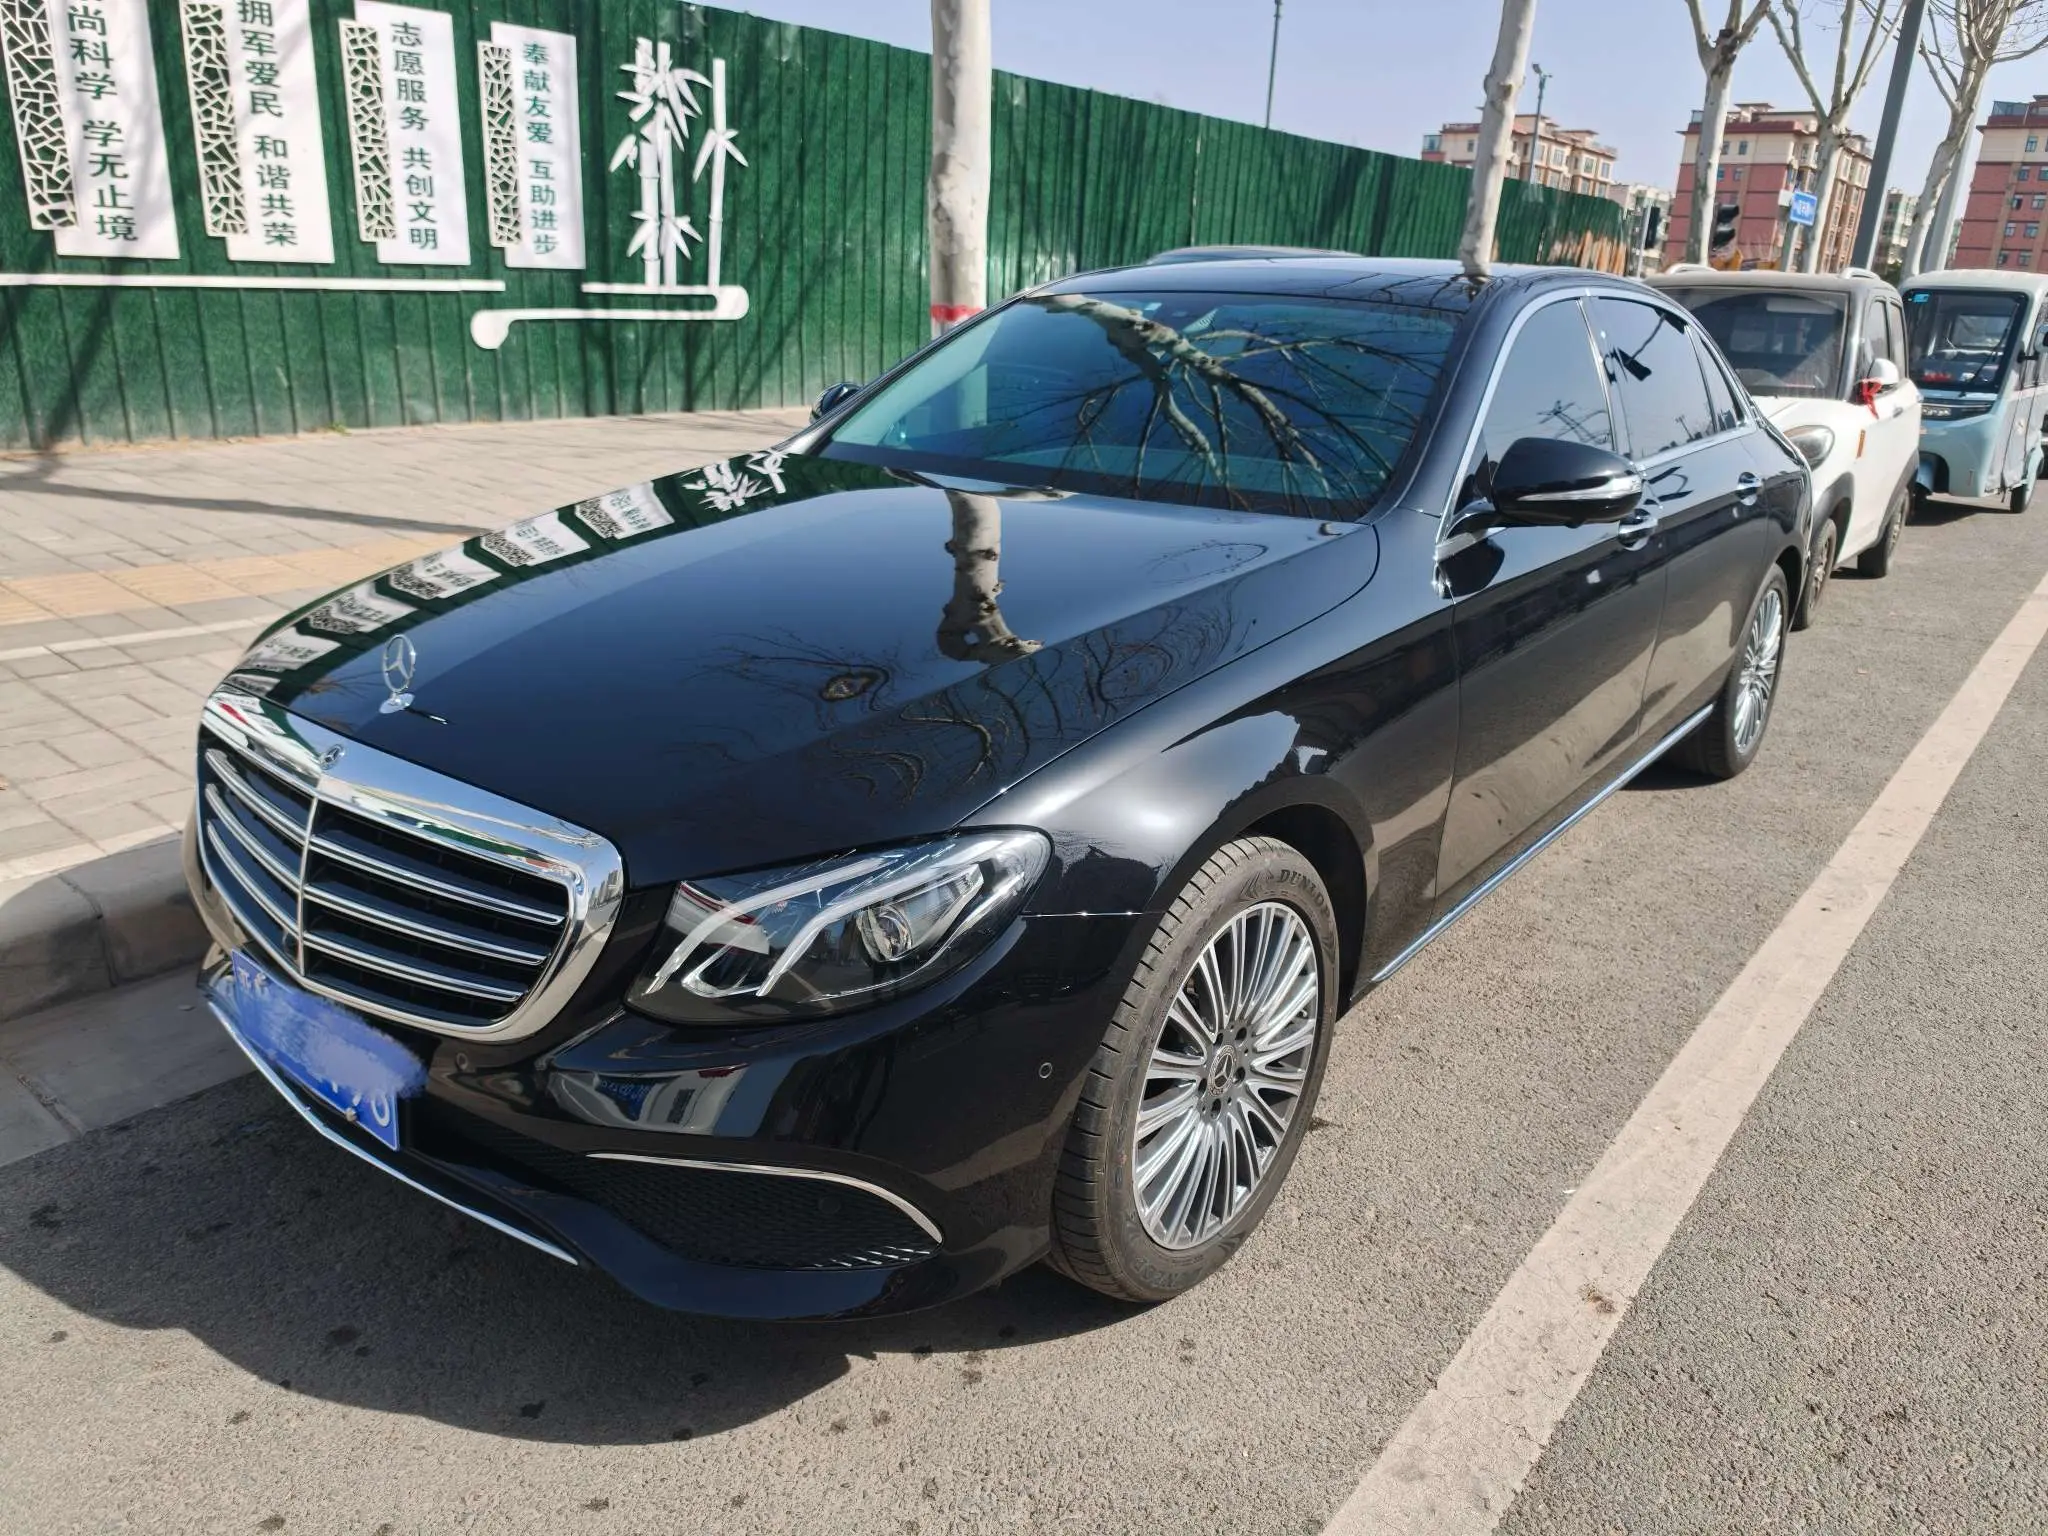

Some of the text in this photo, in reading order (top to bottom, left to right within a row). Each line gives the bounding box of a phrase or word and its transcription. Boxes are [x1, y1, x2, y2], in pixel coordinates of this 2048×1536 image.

[67, 0, 138, 241] 尚科学 学无止境
[237, 0, 298, 247] 拥军爱民 和谐共荣
[391, 22, 438, 250] 志愿服务 共创文明
[523, 41, 559, 255] 奉献友爱 互助进步
